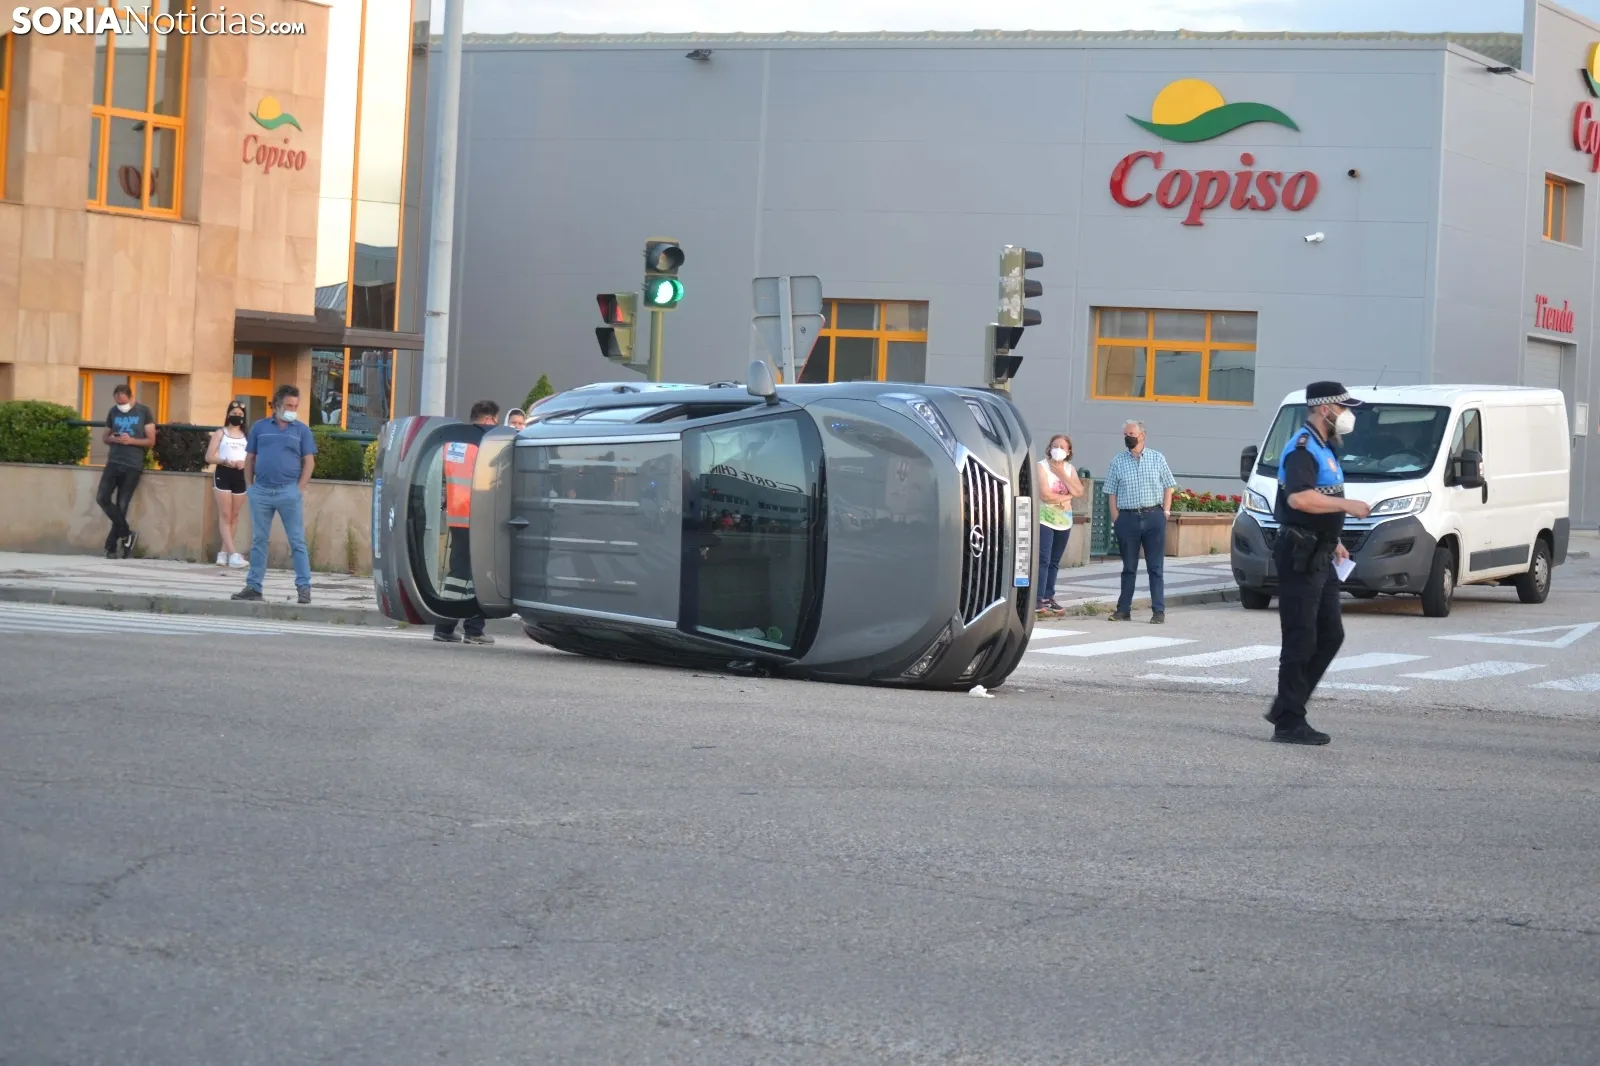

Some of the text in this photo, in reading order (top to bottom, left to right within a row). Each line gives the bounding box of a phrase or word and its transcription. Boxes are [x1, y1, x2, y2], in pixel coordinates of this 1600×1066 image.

[242, 133, 307, 175] Copiso
[1109, 150, 1320, 226] Copiso
[1534, 294, 1574, 334] Tienda
